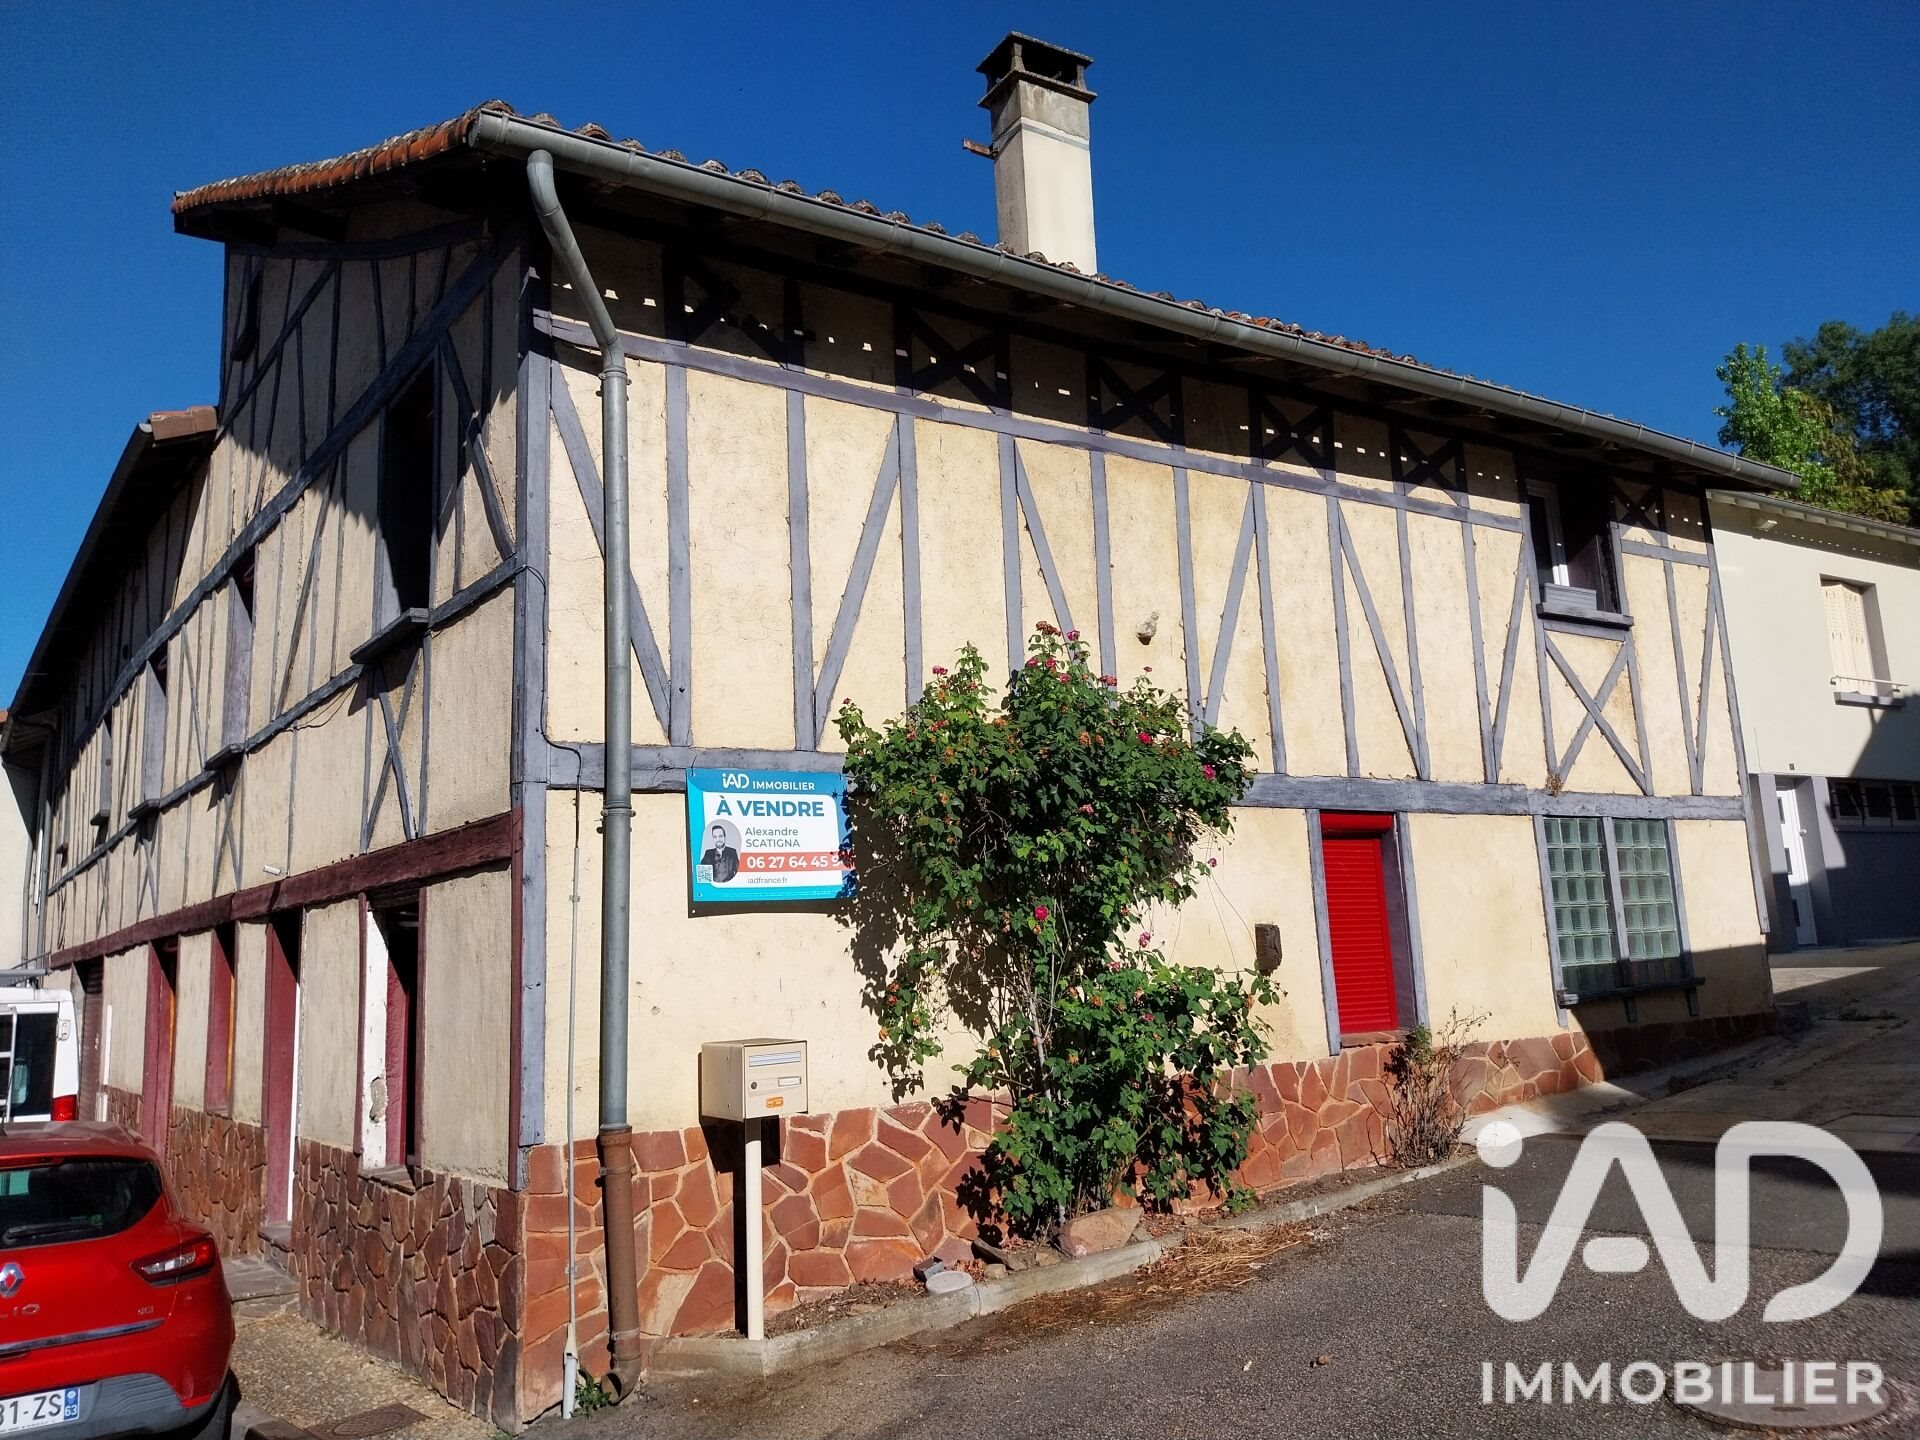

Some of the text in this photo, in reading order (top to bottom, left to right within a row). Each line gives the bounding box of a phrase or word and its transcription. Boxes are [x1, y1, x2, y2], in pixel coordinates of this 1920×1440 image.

[722, 773, 815, 790] iAD IMMOBILIER
[716, 795, 825, 817] À VENDRE
[745, 827, 799, 836] Alexandre
[745, 839, 800, 848] SCATIGNA
[747, 855, 843, 868] 06 27 64 45 9
[65, 1405, 77, 1416] 63
